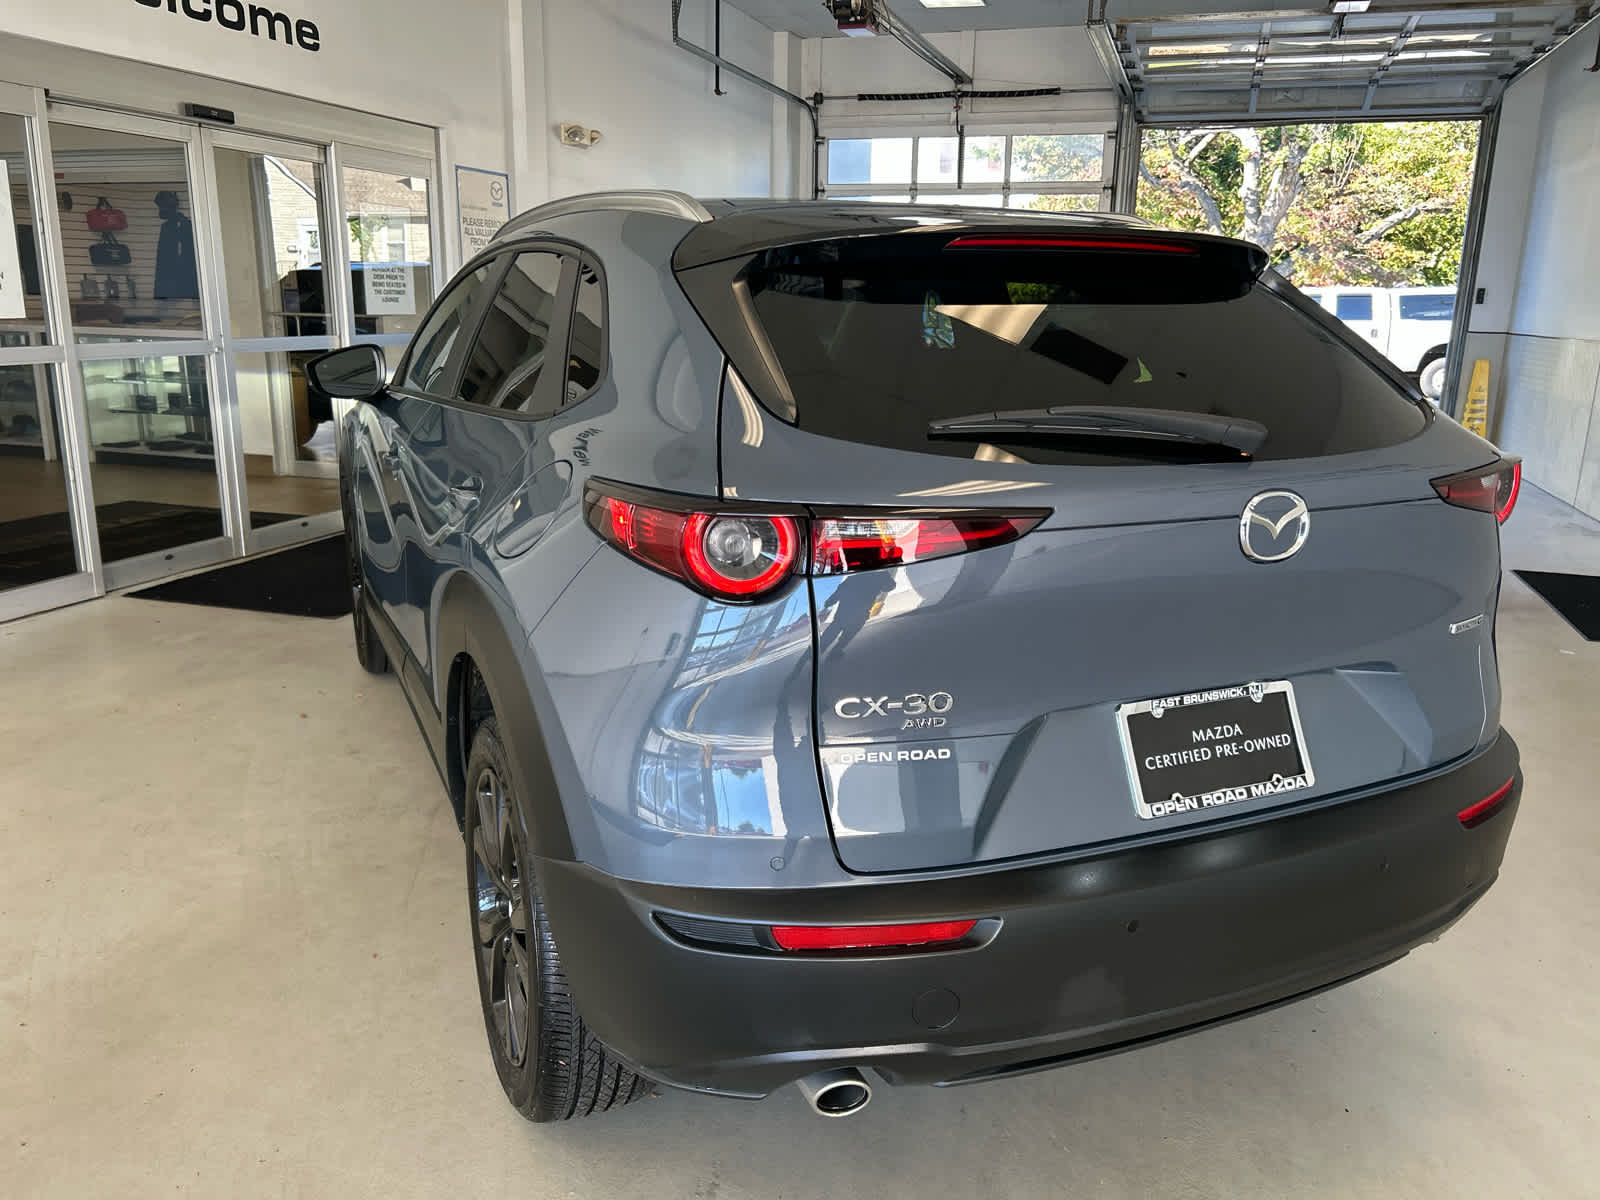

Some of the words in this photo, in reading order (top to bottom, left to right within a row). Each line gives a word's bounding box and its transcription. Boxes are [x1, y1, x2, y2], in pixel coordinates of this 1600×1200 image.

[135, 0, 320, 52] come
[463, 216, 484, 227] PLEASE
[835, 692, 953, 718] CX-30
[1183, 687, 1247, 705] BRUNSWICK,
[902, 717, 946, 730] AWD
[1192, 723, 1243, 743] MAZDA
[840, 751, 893, 763] OPEN
[897, 748, 951, 761] ROAD
[1145, 746, 1211, 770] CERTIFIED
[1215, 733, 1291, 758] PRE-OWNED
[1152, 797, 1198, 816] OPEN
[1202, 788, 1247, 807] ROAD
[1250, 776, 1307, 797] MAZDA
